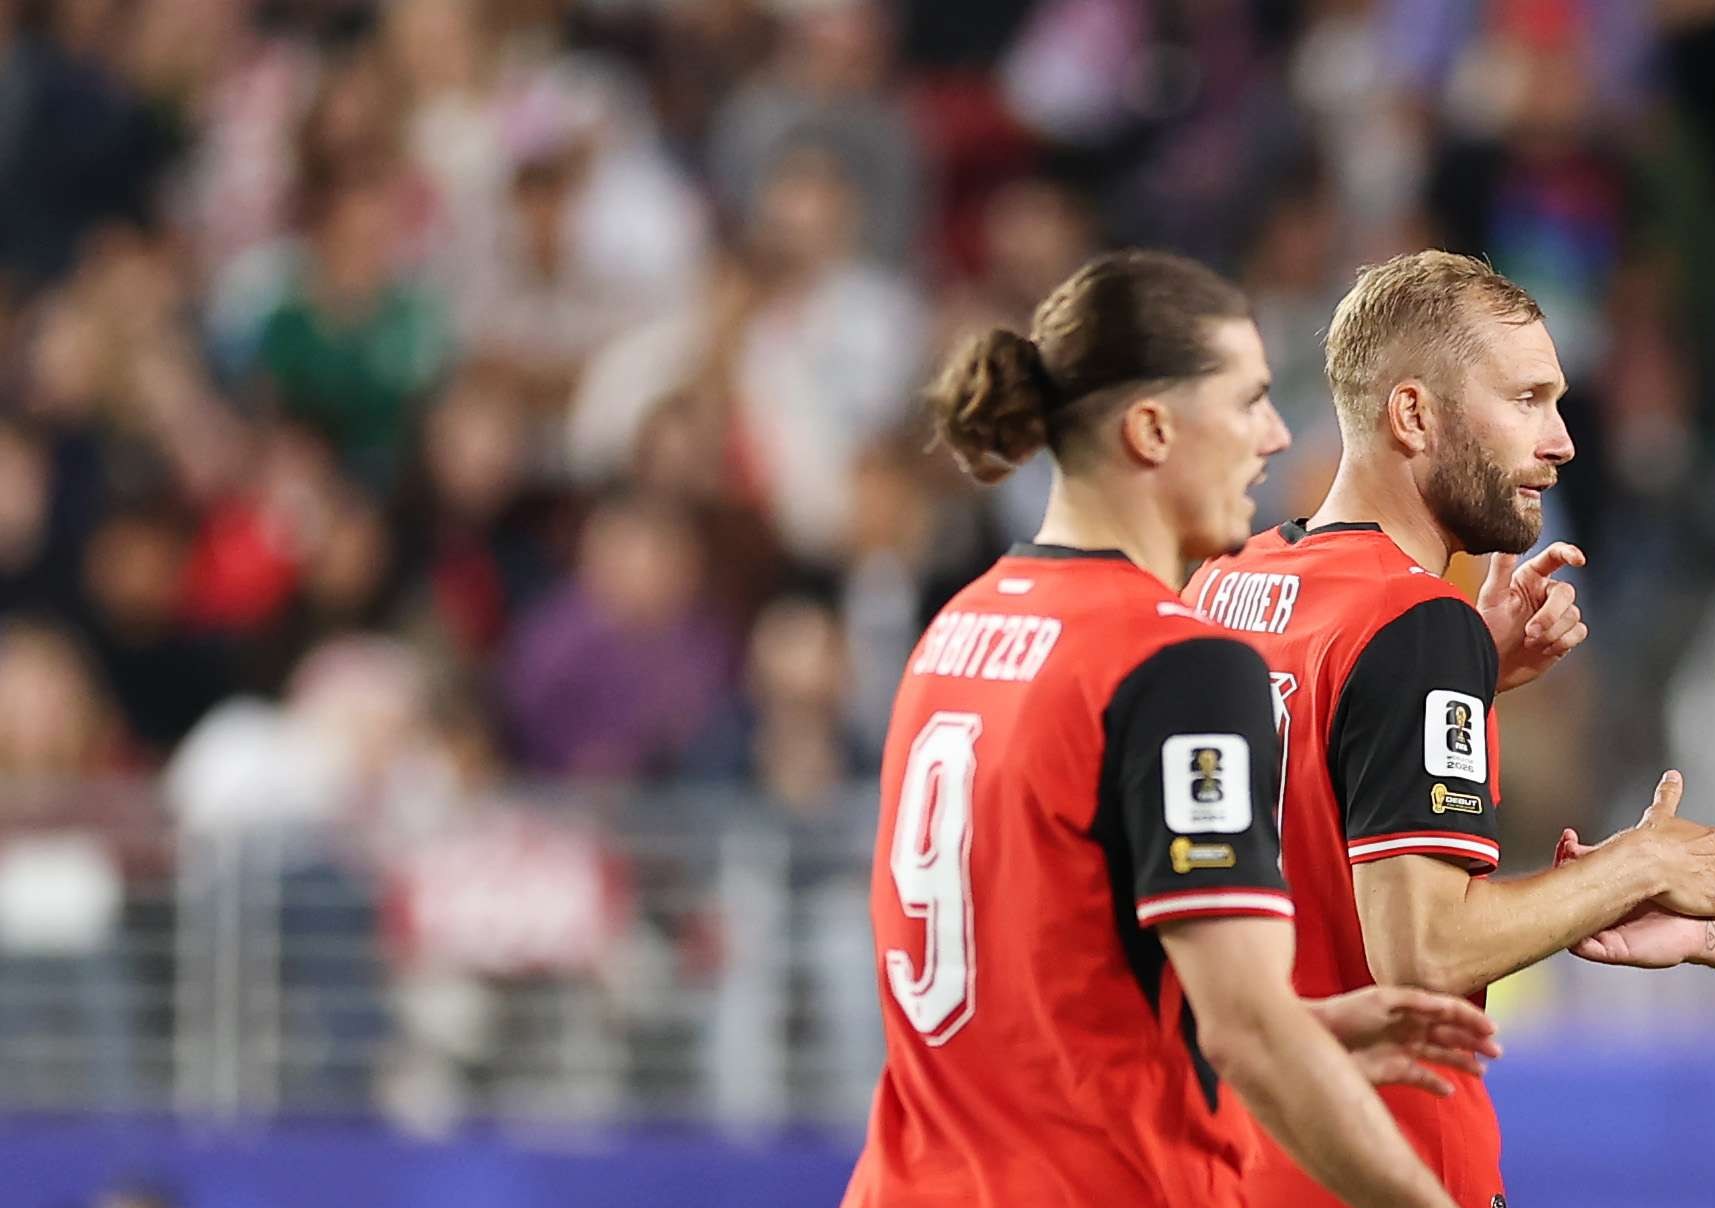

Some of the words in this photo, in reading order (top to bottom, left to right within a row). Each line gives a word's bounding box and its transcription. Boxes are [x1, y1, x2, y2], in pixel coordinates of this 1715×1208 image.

[1194, 568, 1300, 634] LAIMER
[1445, 796, 1478, 807] DEBUT
[886, 712, 982, 1046] 9
